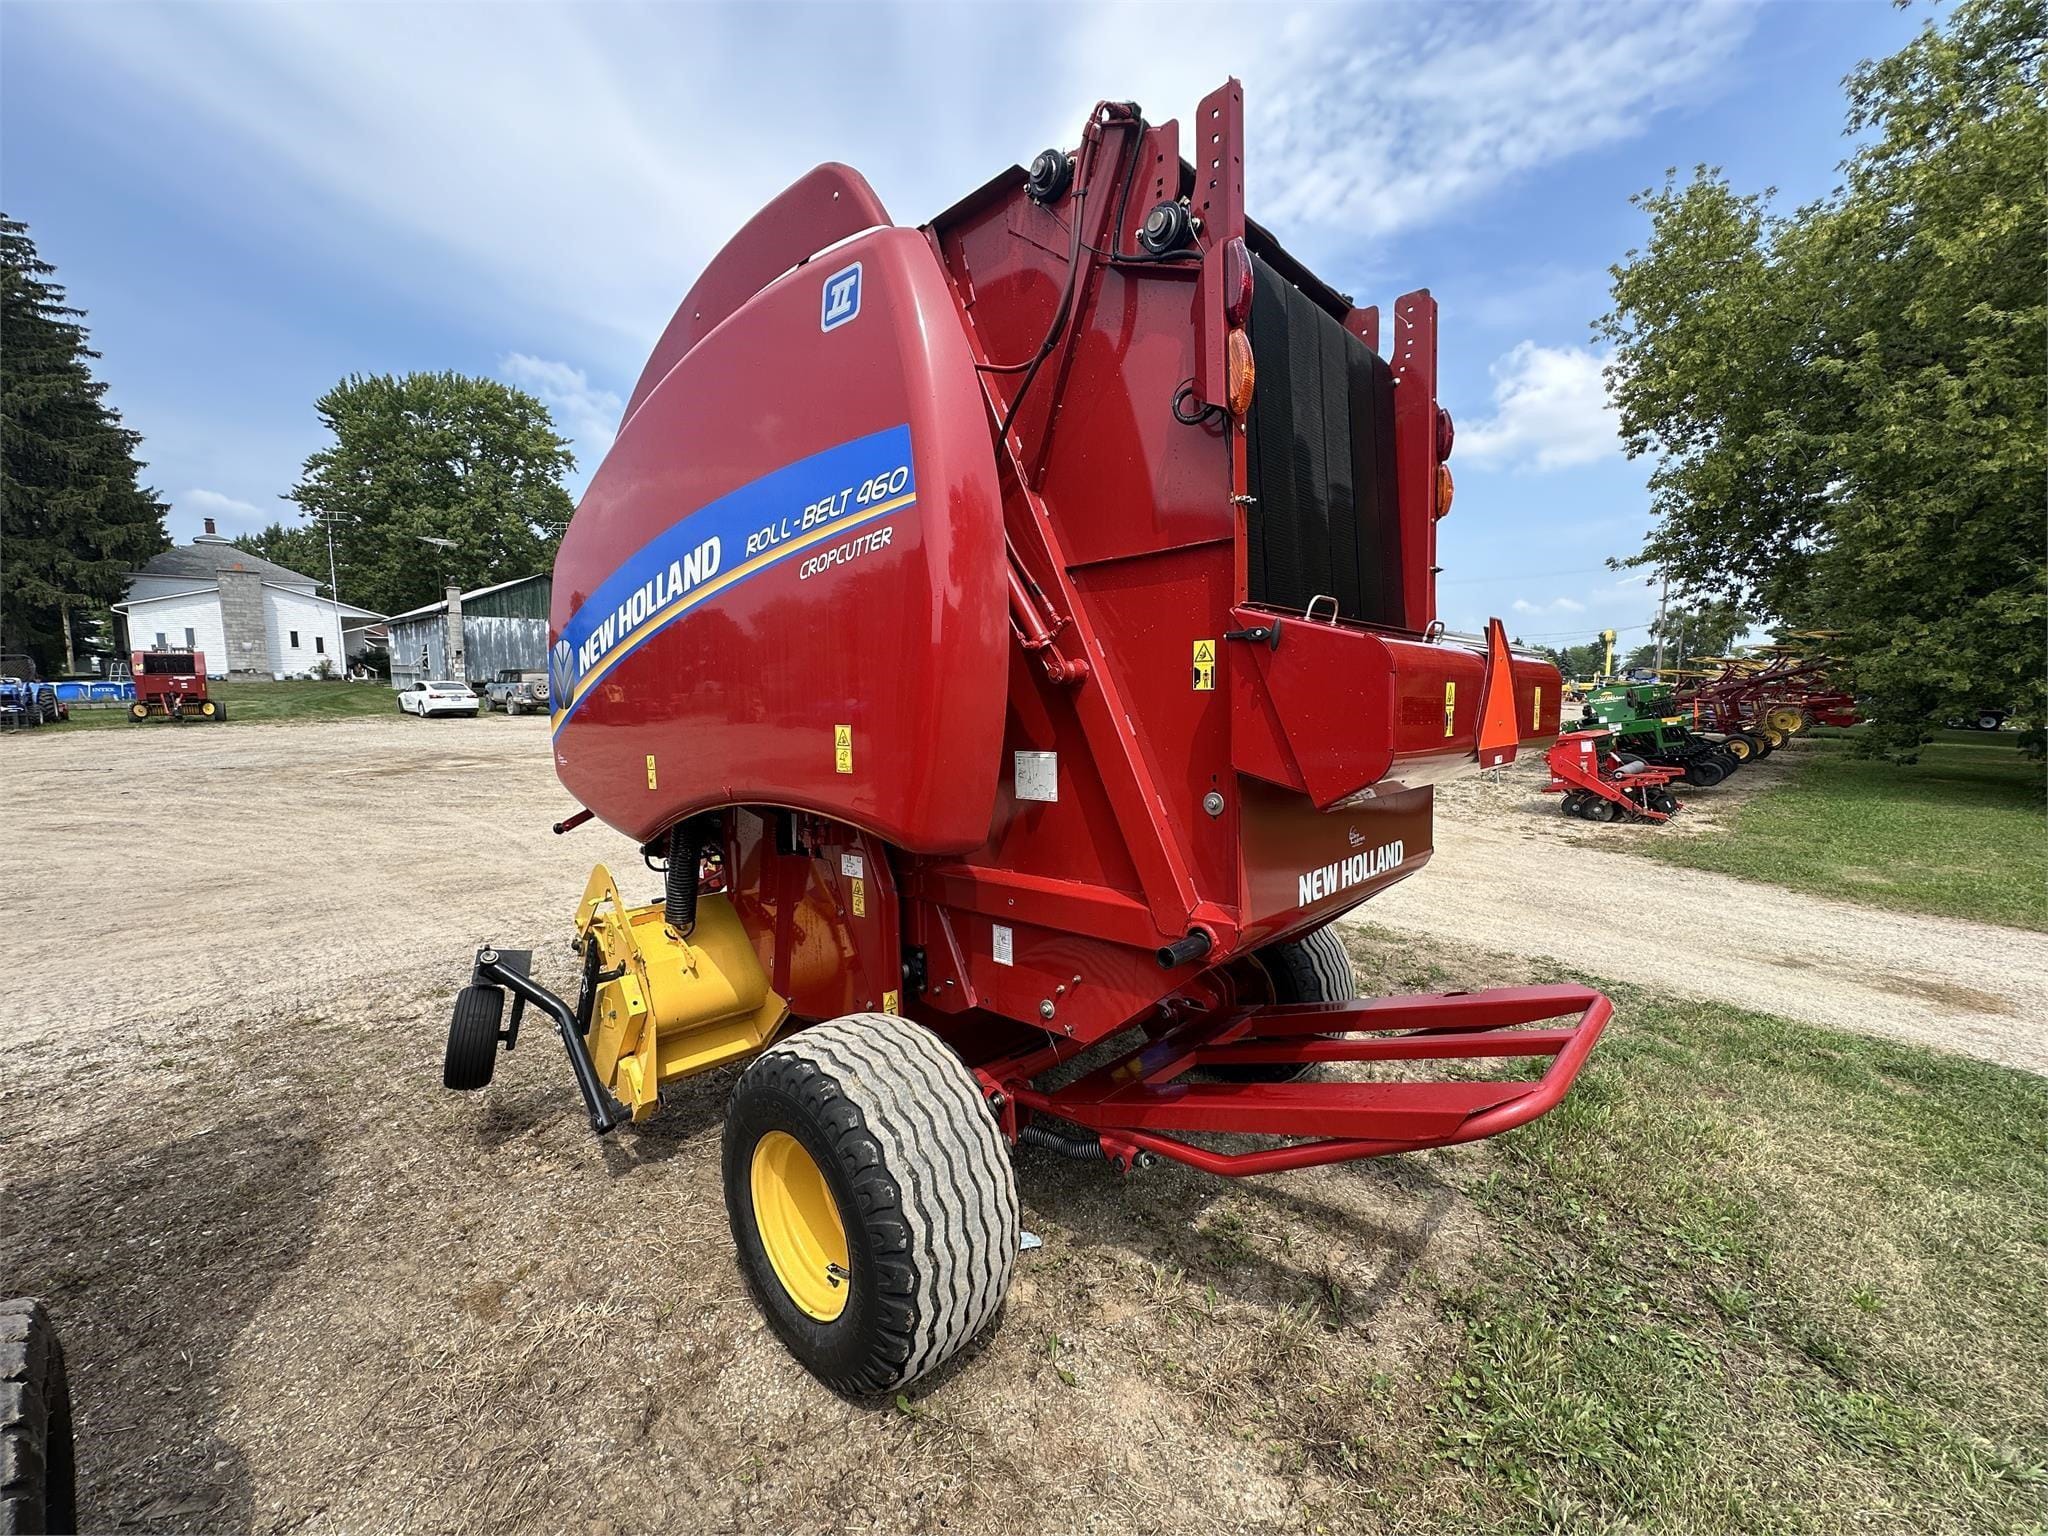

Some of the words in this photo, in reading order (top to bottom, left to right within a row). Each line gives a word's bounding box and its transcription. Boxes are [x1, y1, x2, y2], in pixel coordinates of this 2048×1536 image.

[745, 488, 852, 558] ROLL-BELT
[856, 465, 909, 506] 460
[799, 526, 893, 581] CROPCUTTER
[578, 612, 615, 677] NEW
[618, 535, 722, 639] HOLLAND
[1298, 862, 1338, 907] NEW
[1341, 840, 1404, 888] HOLLAND
